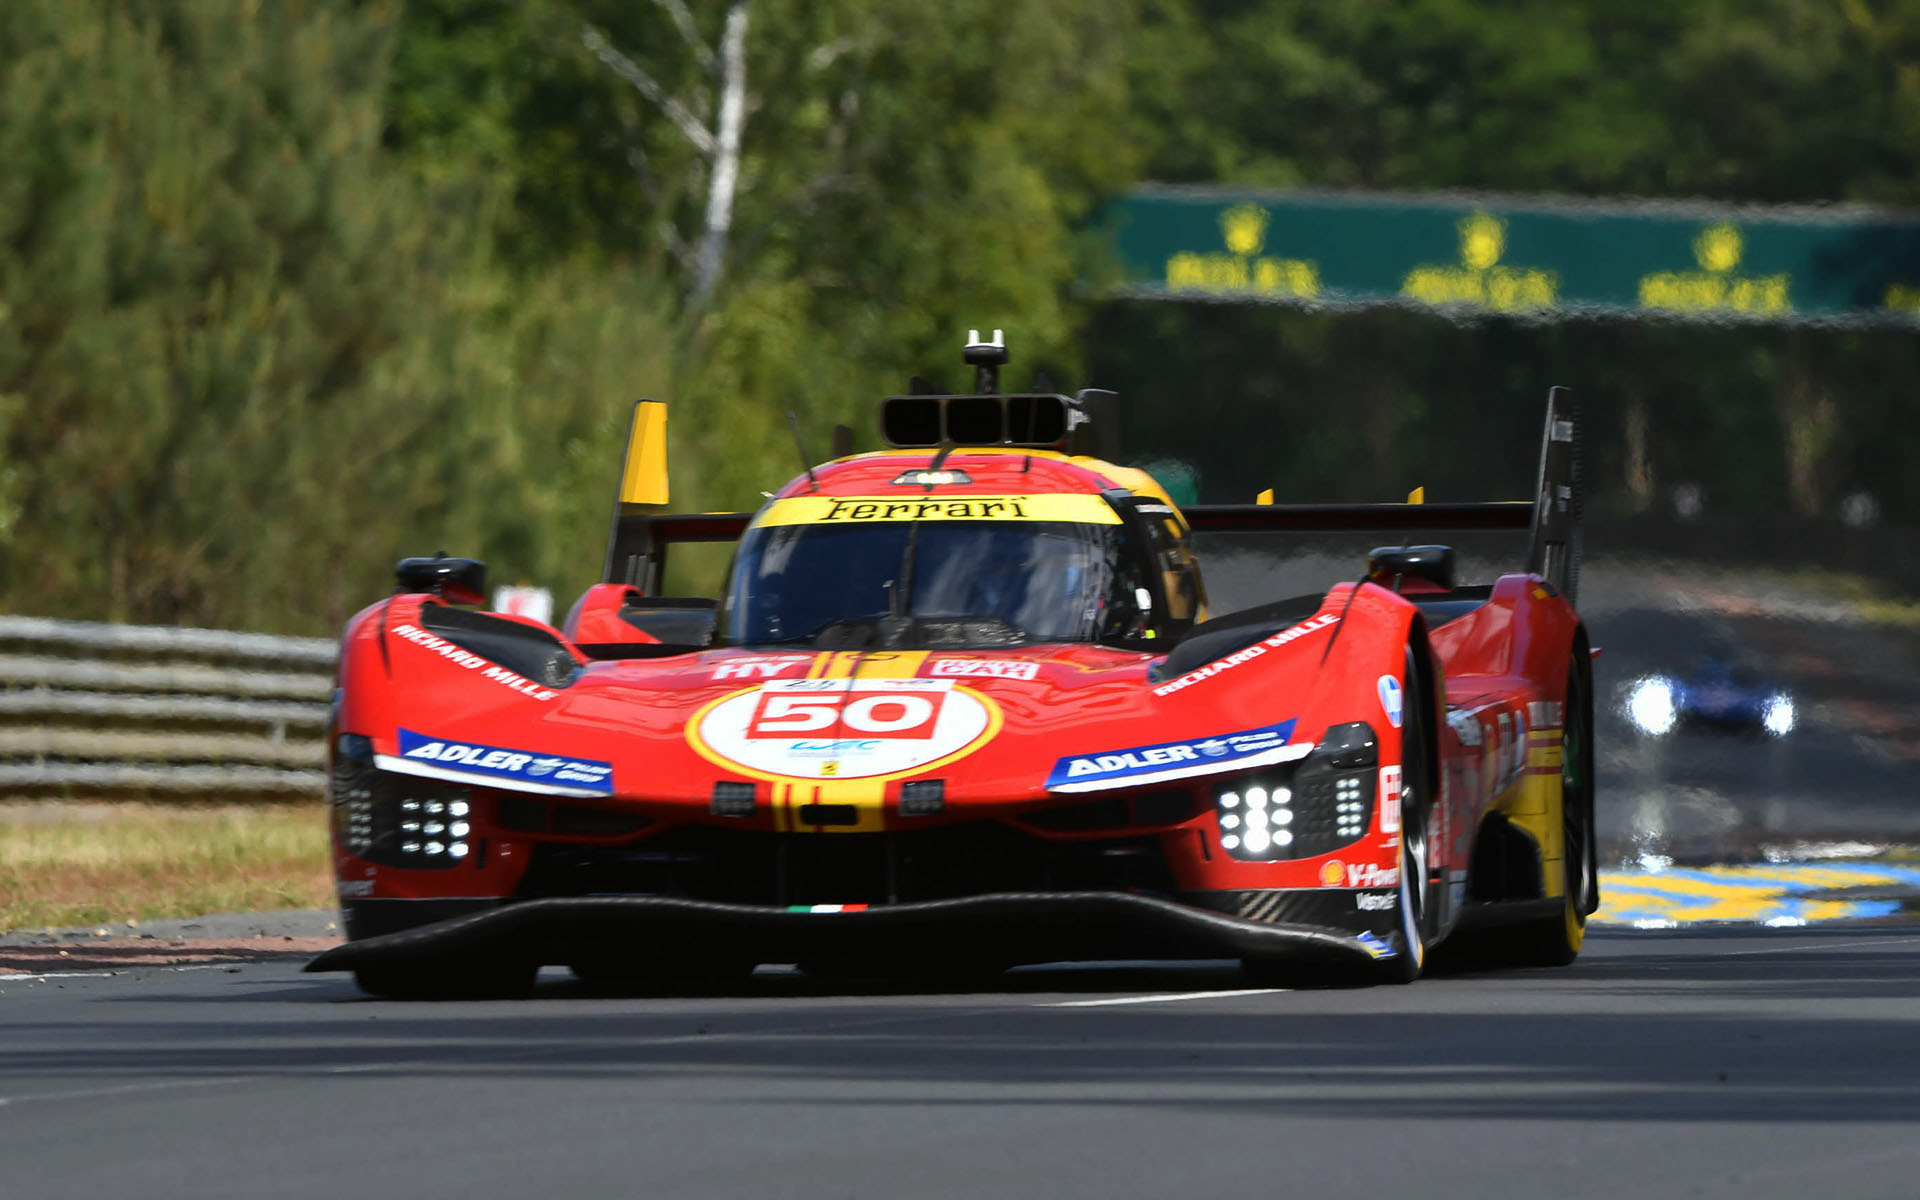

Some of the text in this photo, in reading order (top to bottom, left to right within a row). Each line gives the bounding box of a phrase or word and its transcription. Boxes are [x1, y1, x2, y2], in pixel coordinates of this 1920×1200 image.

[819, 497, 1028, 520] Ferrari
[391, 624, 559, 701] RICHARD MILLE
[711, 661, 797, 680] HY
[1153, 613, 1341, 697] RICHARD MILLE
[756, 695, 933, 733] 50
[403, 742, 533, 772] ADLER
[1066, 744, 1199, 778] ADLER
